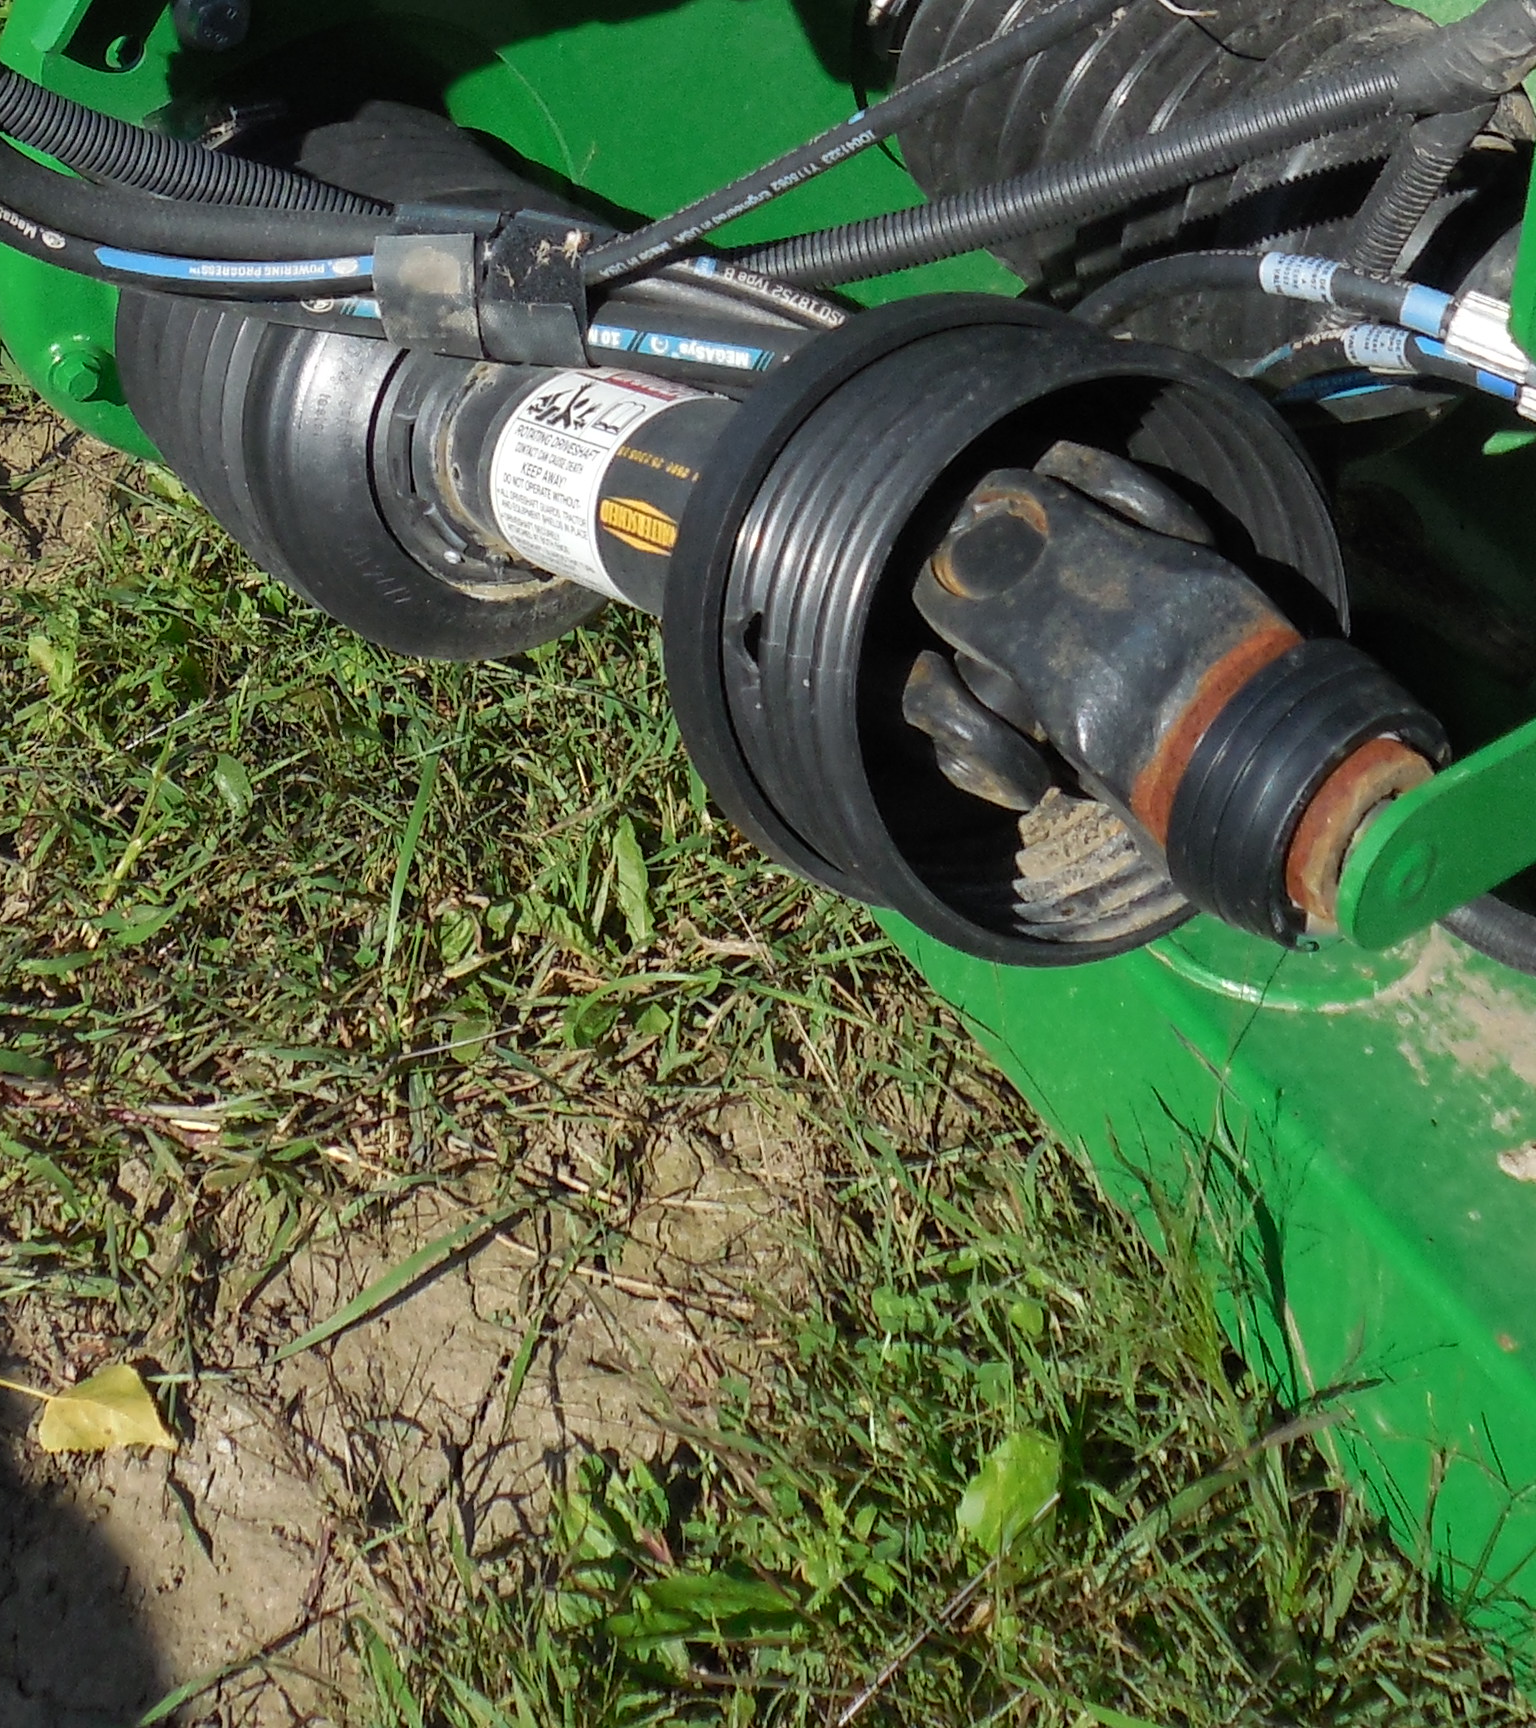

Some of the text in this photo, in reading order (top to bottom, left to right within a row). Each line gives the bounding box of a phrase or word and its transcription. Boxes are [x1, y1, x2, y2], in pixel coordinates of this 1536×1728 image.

[712, 189, 772, 225] Engineered
[673, 225, 702, 244] USA
[264, 262, 325, 276] POWERING
[599, 261, 627, 279] USA
[723, 266, 846, 325] ISO 18752 Type B
[678, 339, 750, 366] MEGASys
[515, 424, 600, 461] ROTATING DRIVESHAFT
[521, 462, 543, 478] KEEP
[503, 472, 511, 484] DO
[512, 476, 524, 488] NOT
[524, 480, 551, 500] OPERATE
